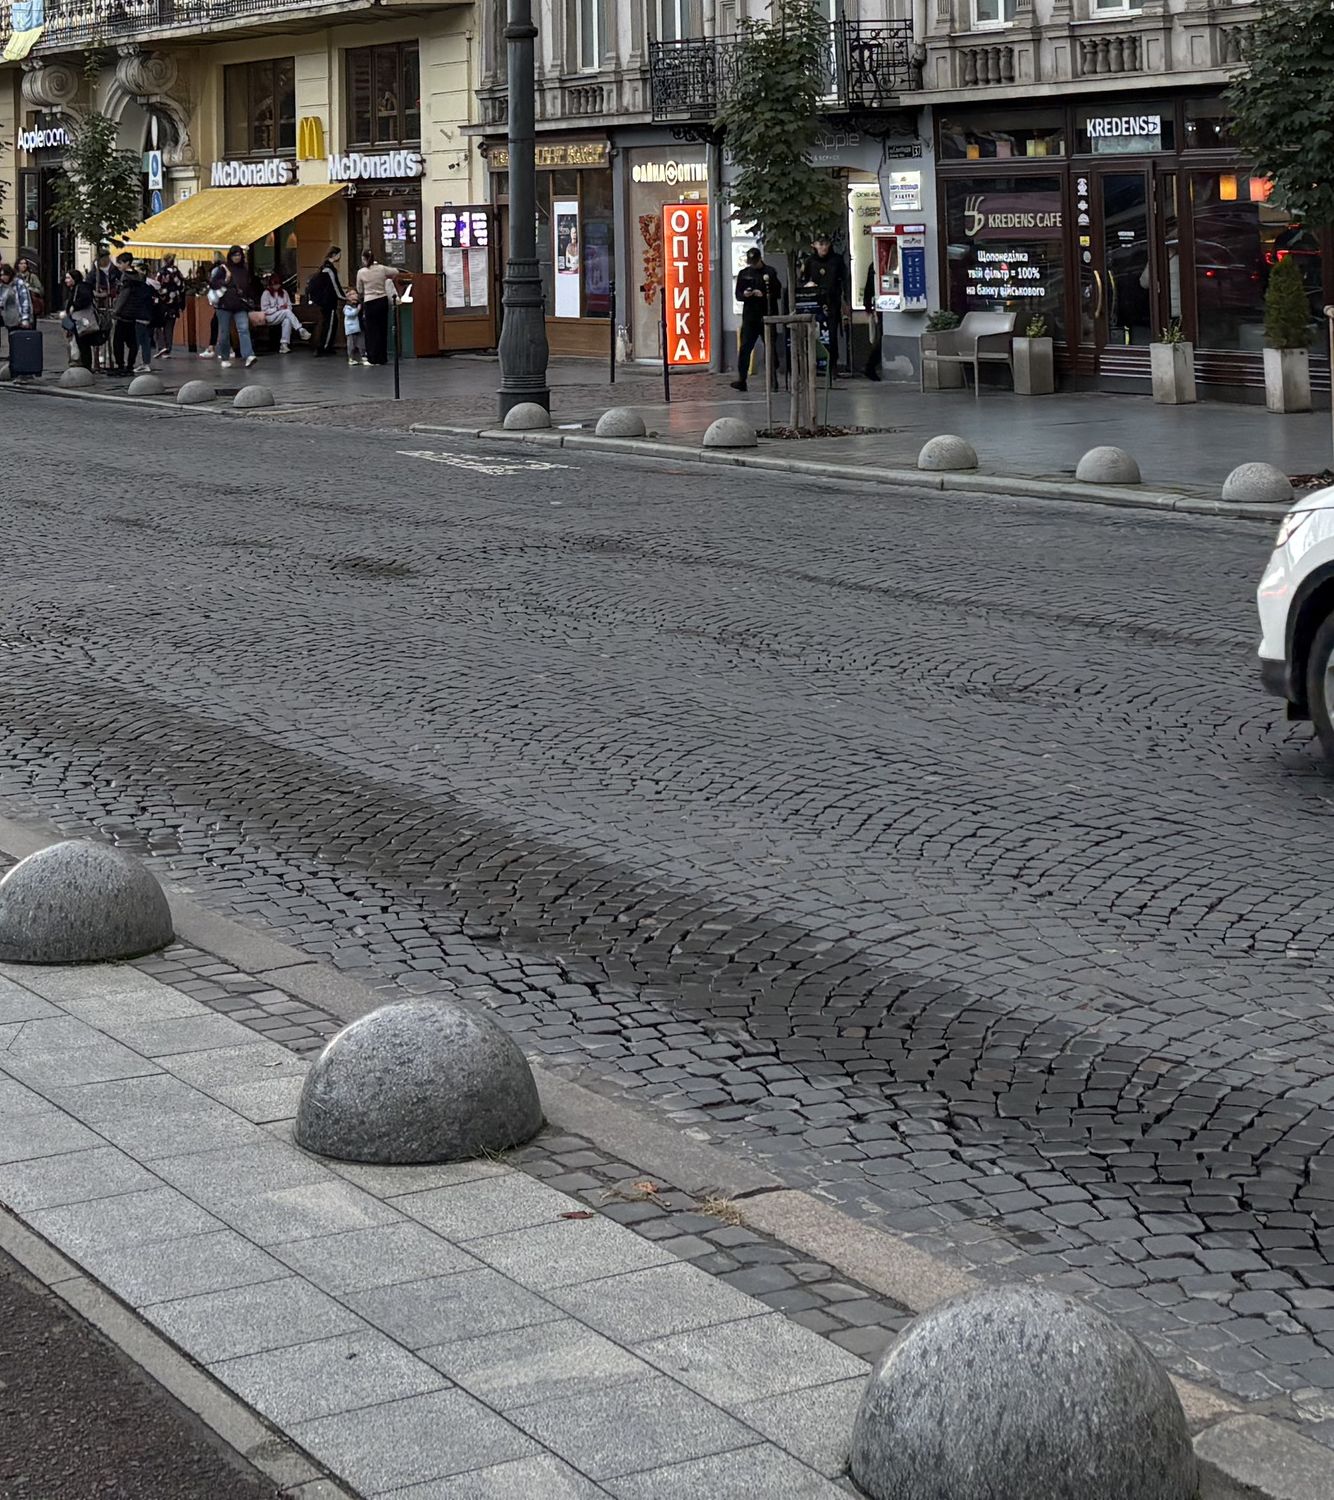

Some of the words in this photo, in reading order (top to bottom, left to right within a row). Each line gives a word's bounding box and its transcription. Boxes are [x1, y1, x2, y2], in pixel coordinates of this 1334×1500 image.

[1087, 116, 1148, 137] KREDENS
[211, 158, 290, 187] McDonald's
[328, 150, 422, 180] McDonald's
[632, 161, 666, 183] ФАЙНА
[677, 162, 708, 182] ОПТИК
[988, 213, 1035, 228] KREDENS
[1036, 212, 1062, 228] CAFE
[696, 209, 704, 283] СЛУХОВІ
[670, 209, 693, 361] ОПТИКА
[1017, 266, 1041, 279] 100%
[965, 285, 976, 295] на
[976, 283, 999, 298] банку
[698, 286, 706, 360] АПАРАТИ
